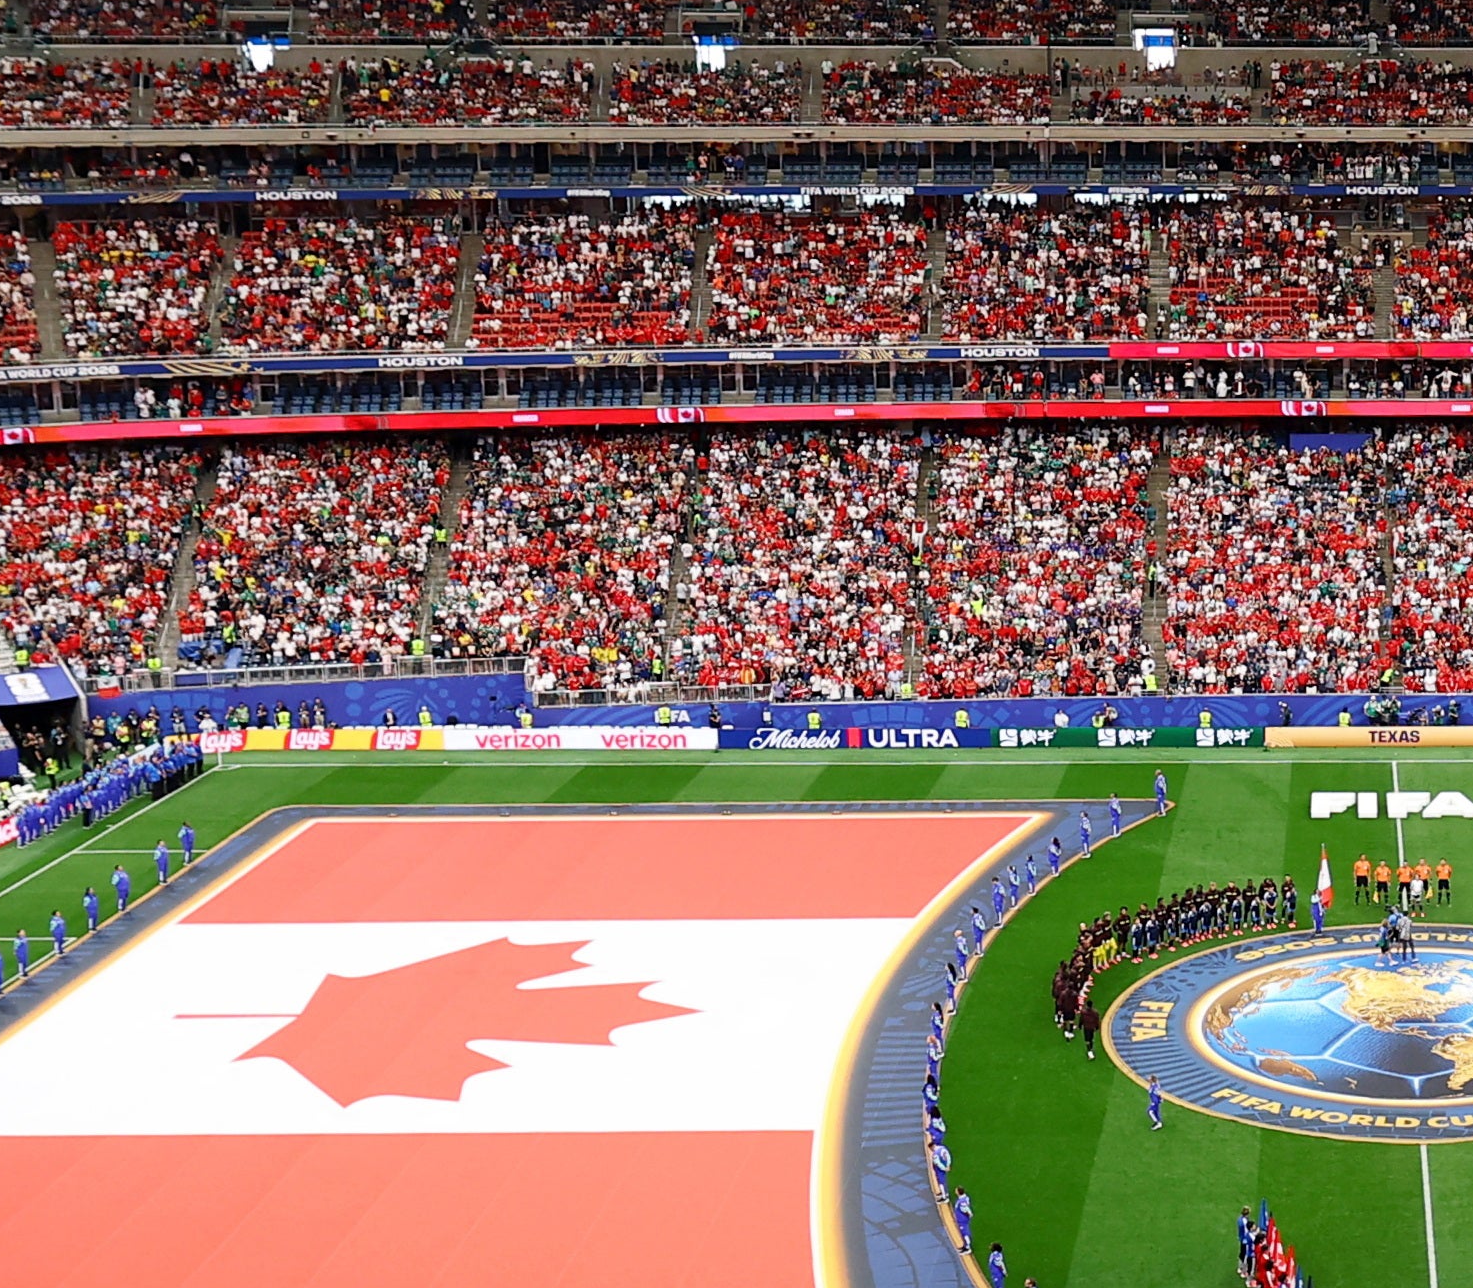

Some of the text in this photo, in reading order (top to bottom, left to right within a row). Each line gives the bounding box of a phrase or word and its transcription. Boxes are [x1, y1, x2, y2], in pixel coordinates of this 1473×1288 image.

[255, 190, 338, 201] HOUSTON
[800, 187, 915, 196] FIFA WORLD CUP 2026
[1346, 186, 1419, 196] HOUSTON
[0, 195, 43, 205] 2026
[960, 348, 1039, 358] HOUSTON
[378, 356, 463, 367] HOUSTON
[8, 369, 47, 380] WORLD
[49, 367, 78, 378] CUP
[79, 365, 120, 377] 2026
[289, 729, 330, 750] Lay's
[376, 729, 418, 750] Lay's
[475, 729, 560, 749] verizon
[601, 729, 687, 749] verizon
[749, 728, 958, 749] Michelob ULTRA
[1369, 730, 1420, 744] TEXAS
[1131, 999, 1176, 1042] FIFA
[1210, 1087, 1286, 1117] FIFA
[1289, 1103, 1420, 1128] WORLD
